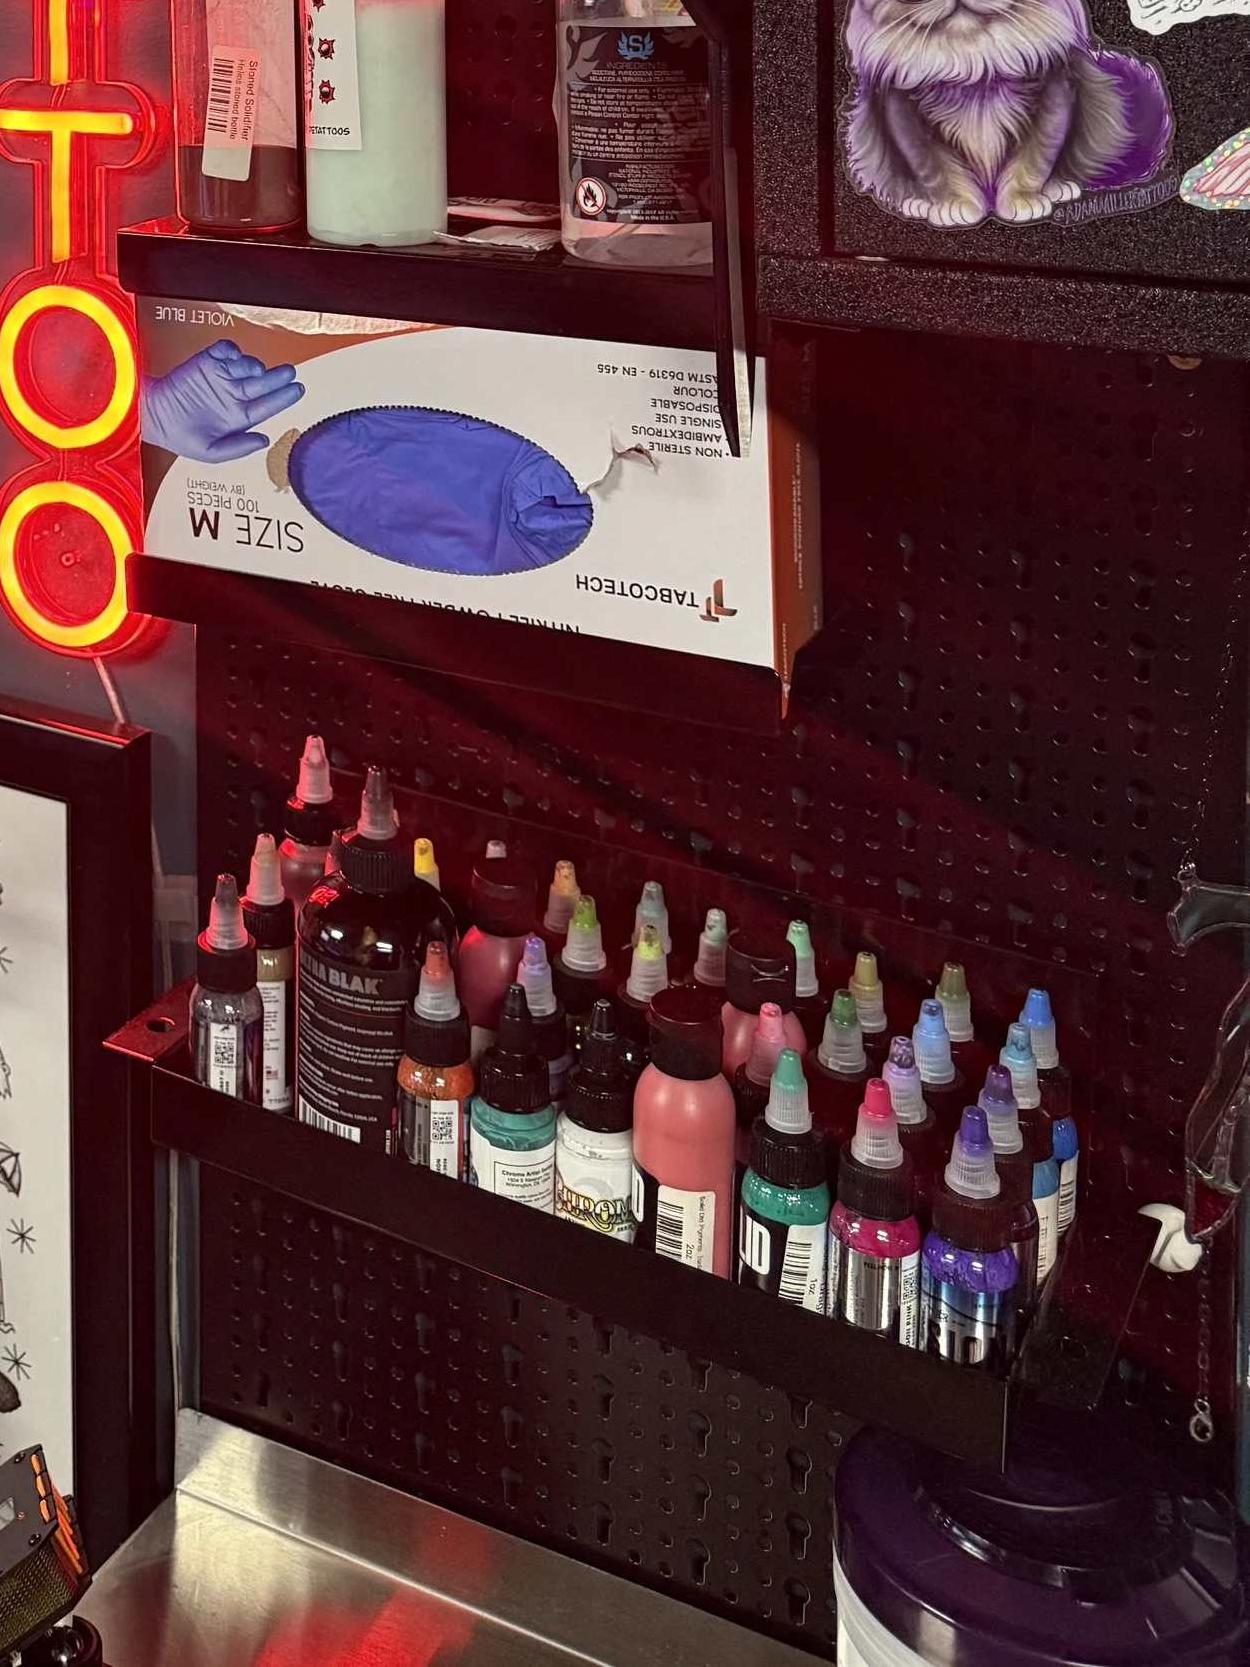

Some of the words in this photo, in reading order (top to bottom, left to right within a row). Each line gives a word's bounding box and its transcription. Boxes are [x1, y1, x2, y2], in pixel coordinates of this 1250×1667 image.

[155, 305, 186, 322] BLUE
[190, 308, 235, 327] VIOLET
[597, 364, 618, 374] 455
[622, 366, 637, 377] EN
[649, 368, 684, 381] D6319
[650, 398, 721, 414] DISPOSABLE
[655, 413, 677, 424] USE
[680, 415, 722, 429] SINGLE
[631, 425, 722, 443] AMBIDEXTROUS
[648, 441, 691, 455] STERILE
[695, 446, 722, 458] NON
[186, 478, 228, 493] WEIGHT)
[231, 483, 246, 495] (BY
[187, 492, 232, 509] PIECES
[237, 498, 260, 513] 100
[188, 507, 221, 540] M
[235, 513, 304, 553] SIZE
[575, 574, 700, 608] TABCOTECH
[328, 968, 380, 994] BLAK
[686, 1244, 694, 1260] 2oz
[808, 1278, 817, 1295] 1oz
